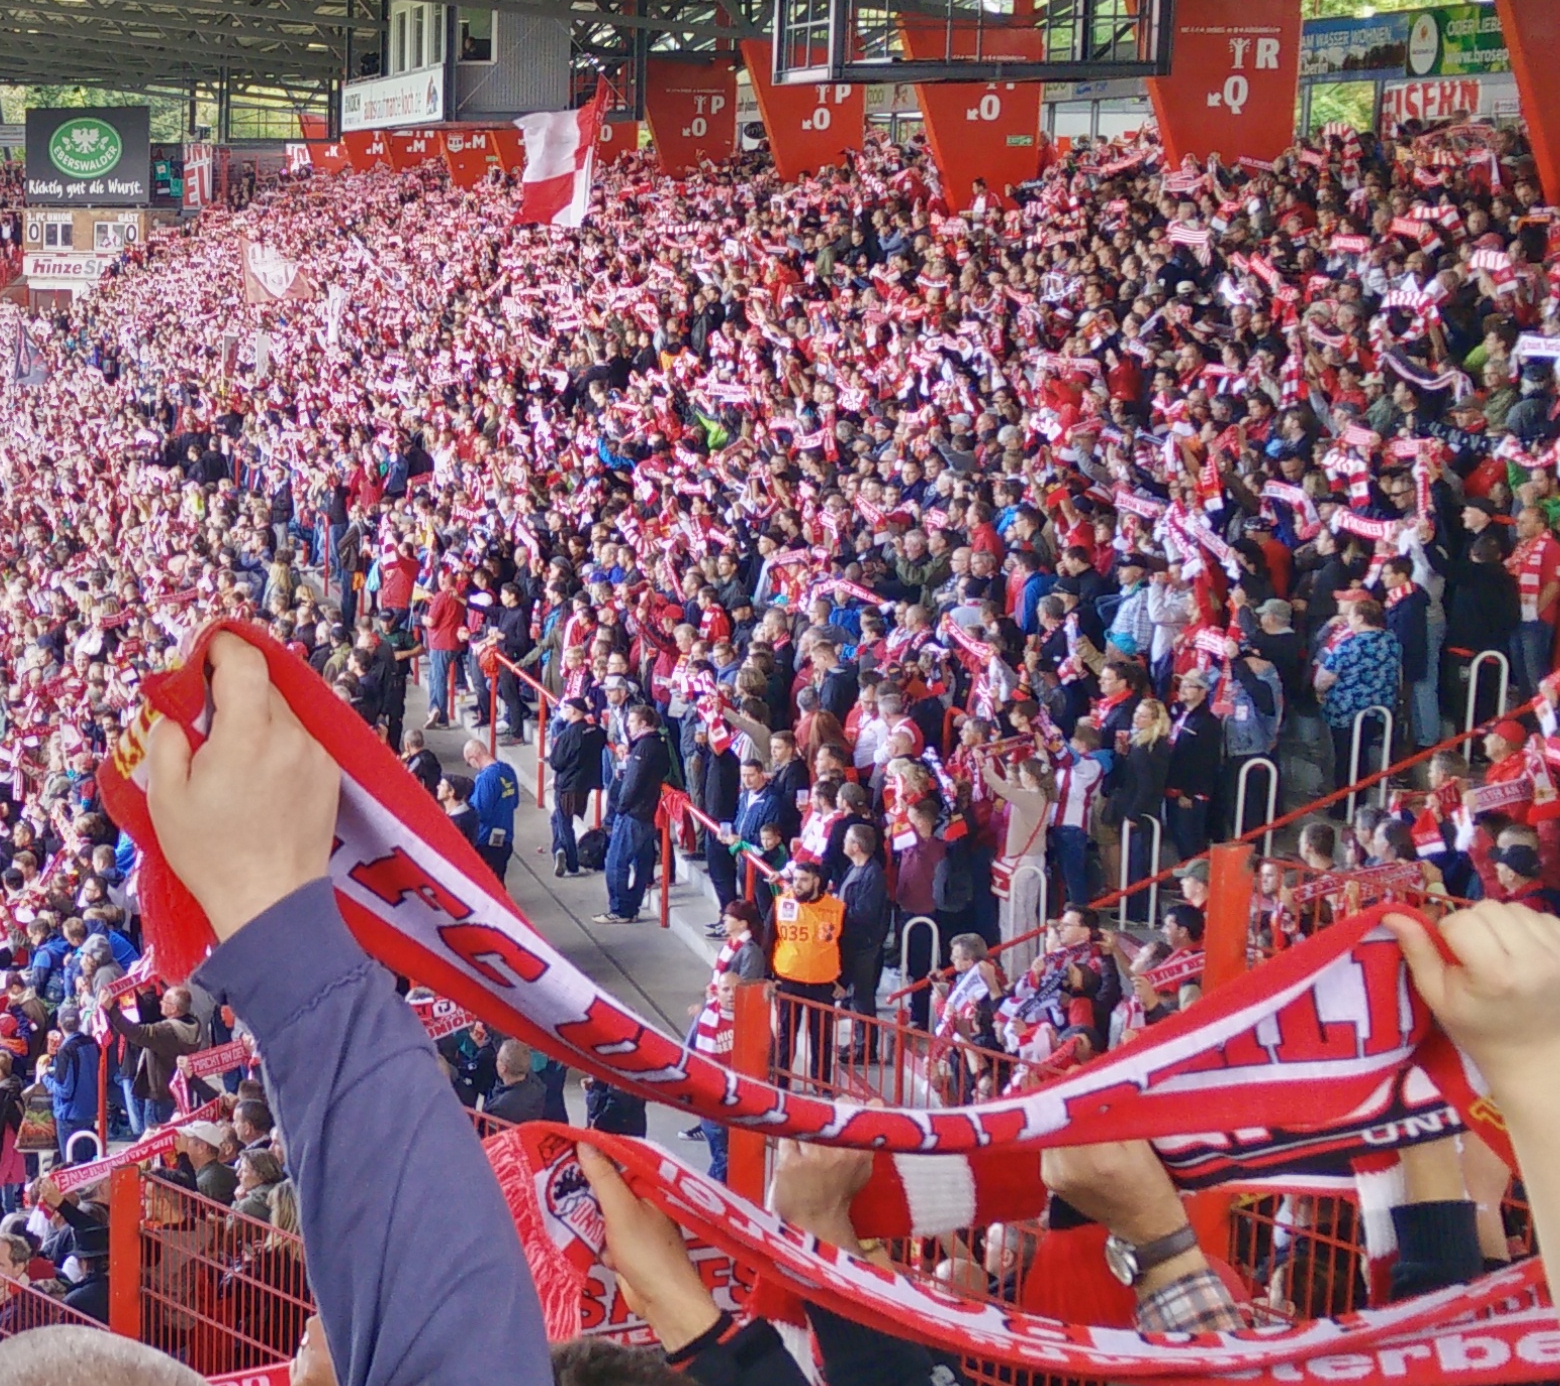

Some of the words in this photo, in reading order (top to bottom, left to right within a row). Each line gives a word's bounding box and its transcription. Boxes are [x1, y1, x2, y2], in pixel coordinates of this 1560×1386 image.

[1316, 31, 1349, 47] WASSER
[1255, 37, 1281, 70] R
[710, 95, 726, 114] P
[1223, 75, 1249, 115] Q
[690, 117, 707, 137] O
[811, 108, 831, 131] O
[52, 144, 119, 172] EBERSWALDER
[28, 179, 63, 198] Richtig
[66, 181, 86, 199] gut
[89, 178, 105, 194] die
[47, 213, 72, 222] UNION
[28, 223, 39, 242] 0
[125, 224, 137, 243] 0
[779, 925, 810, 942] 035
